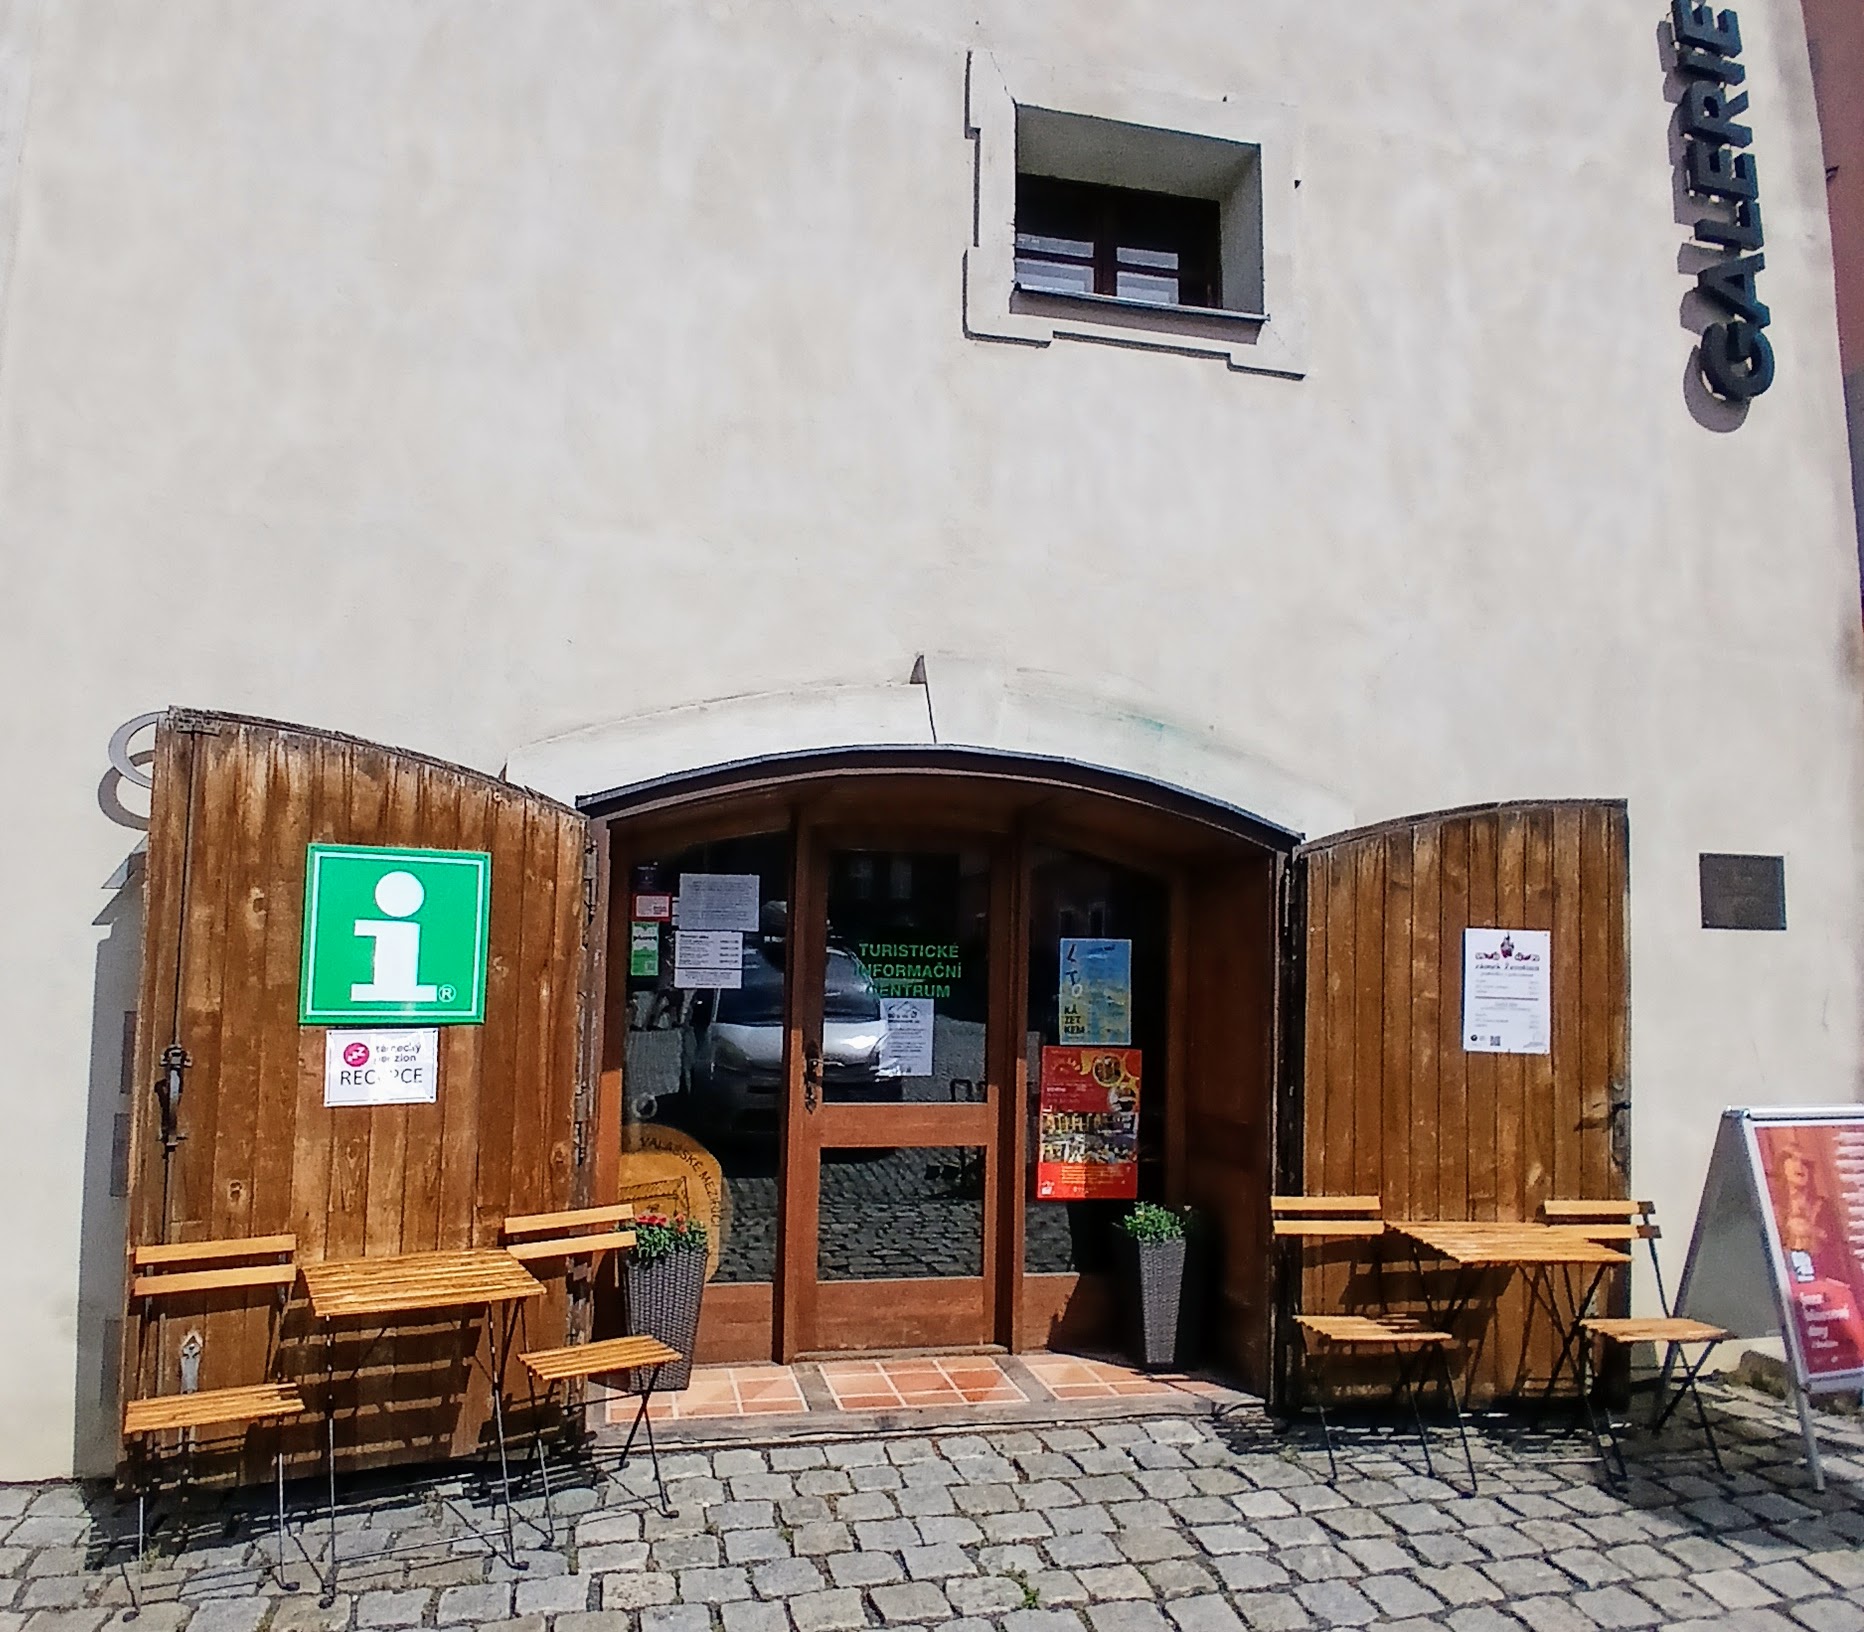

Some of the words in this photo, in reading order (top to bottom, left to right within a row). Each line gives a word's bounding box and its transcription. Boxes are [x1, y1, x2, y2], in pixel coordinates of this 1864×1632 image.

[1670, 0, 1775, 401] GALERIE
[858, 943, 959, 958] TURISTICKÉ
[340, 1067, 423, 1086] RECCE
